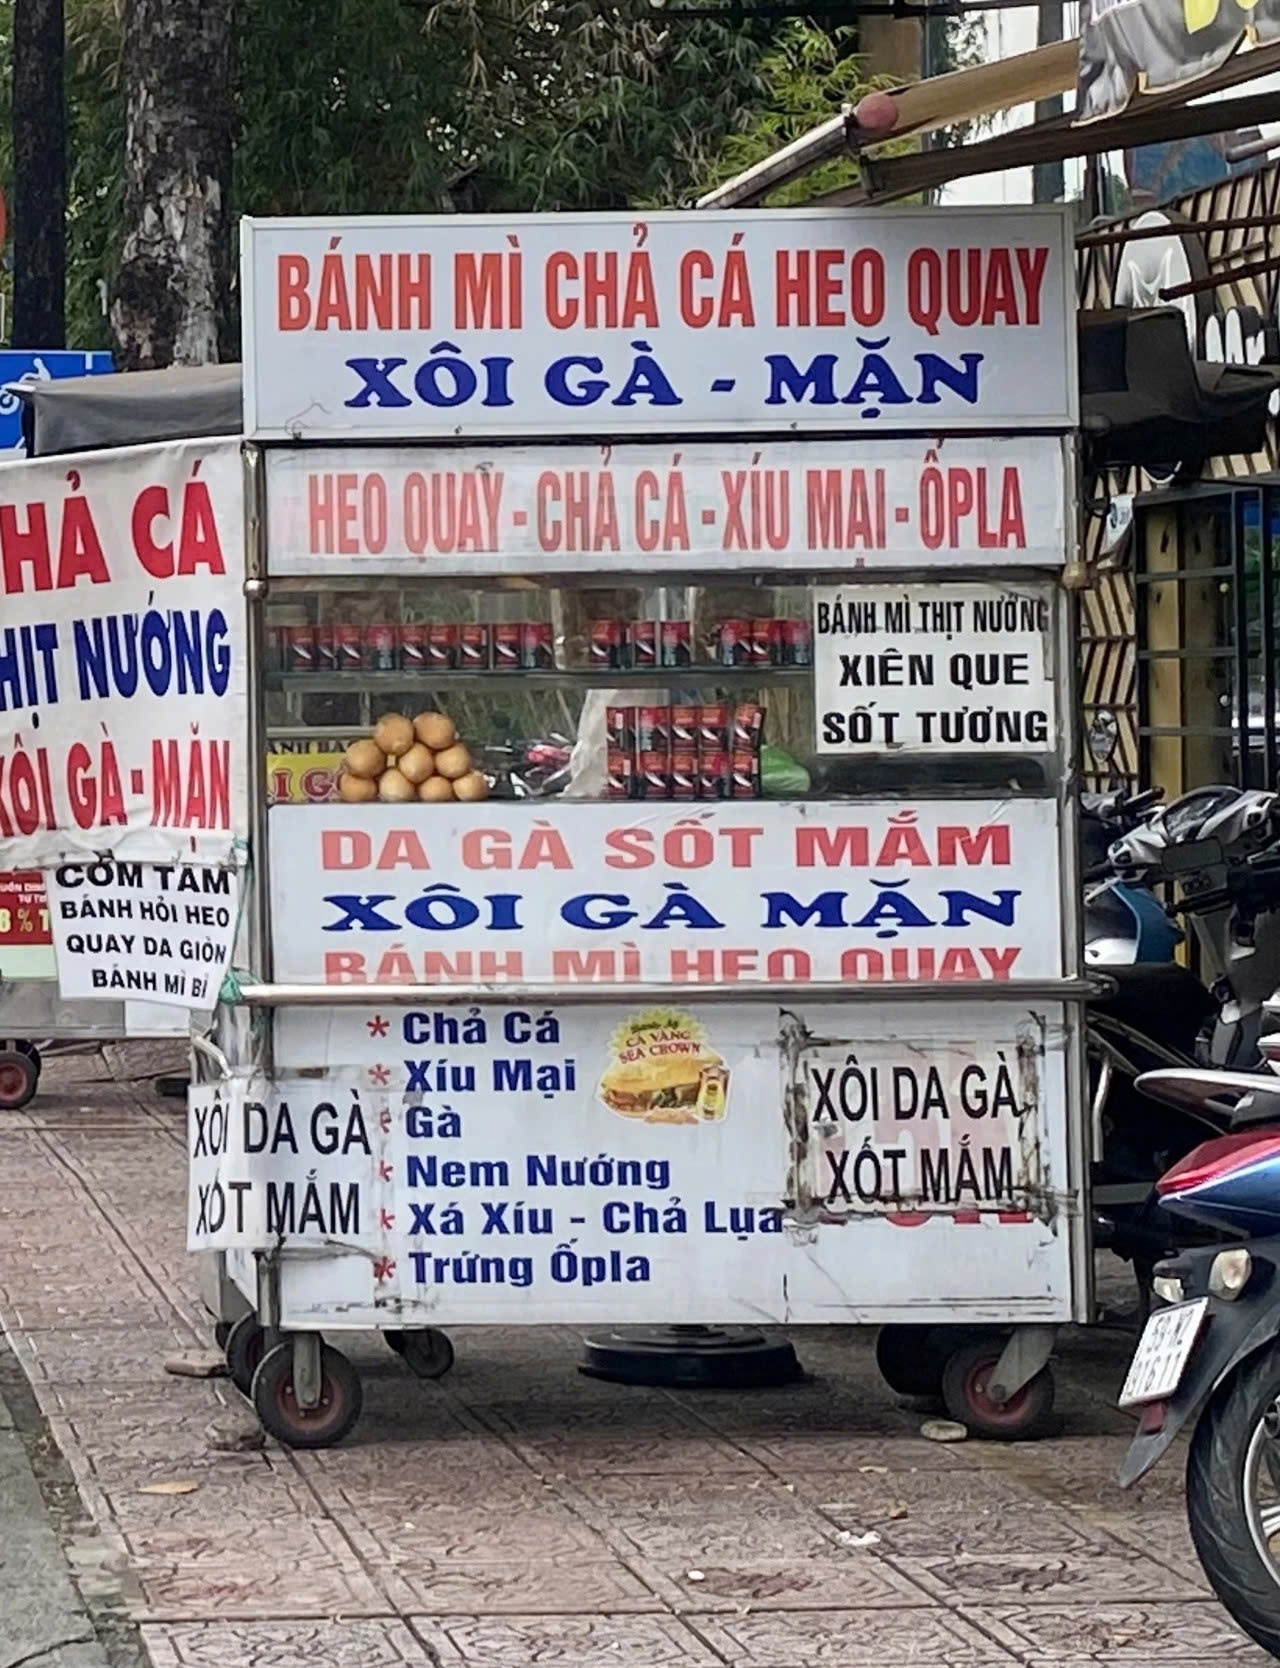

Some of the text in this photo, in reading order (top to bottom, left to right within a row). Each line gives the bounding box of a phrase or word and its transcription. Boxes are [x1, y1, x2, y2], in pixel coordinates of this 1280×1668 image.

[277, 223, 1049, 336] BÁNH MÌ CHẢ CÁ HEO QUAY
[345, 341, 514, 407] XÔI
[544, 341, 682, 407] GÀ
[764, 336, 983, 419] MẶN
[131, 459, 227, 579] CÁ
[308, 473, 388, 555] HEO
[818, 592, 1049, 641] BÁNH MÌ THỊT NƯỚNG
[72, 590, 231, 701] NƯỚNG
[839, 647, 1029, 691] XIÊN QUE
[822, 701, 1048, 744] SỐT TƯƠNG
[321, 810, 1011, 871] DA GÀ SỐT MẮM
[60, 894, 133, 919] BÁNH
[139, 895, 179, 923] HỎI
[184, 904, 230, 928] HEO
[321, 878, 1022, 938] XÔI GÀ MẶN
[66, 933, 136, 954] QUAY
[143, 936, 173, 958] DA
[325, 942, 1022, 985] BÁNH MÌ HEO QUAY
[91, 963, 157, 991] BÁNH
[164, 969, 186, 996] MÌ
[403, 1007, 560, 1045] Chả Cá
[403, 1059, 575, 1099] Xíu Mại
[811, 1051, 1020, 1122] XÔI DA GÀ
[194, 1088, 371, 1158] XÔI DA GÀ
[406, 1105, 461, 1138] Gà
[407, 1153, 671, 1189] Nem Nướng
[825, 1134, 1013, 1204] XỐT MẮM
[266, 1168, 359, 1234] MẮM
[407, 1201, 464, 1235] Xá
[481, 1201, 553, 1235] Xíu
[603, 1196, 687, 1234] Chả
[705, 1201, 783, 1241] Lụa
[408, 1239, 651, 1287] Trứng Ốpla
